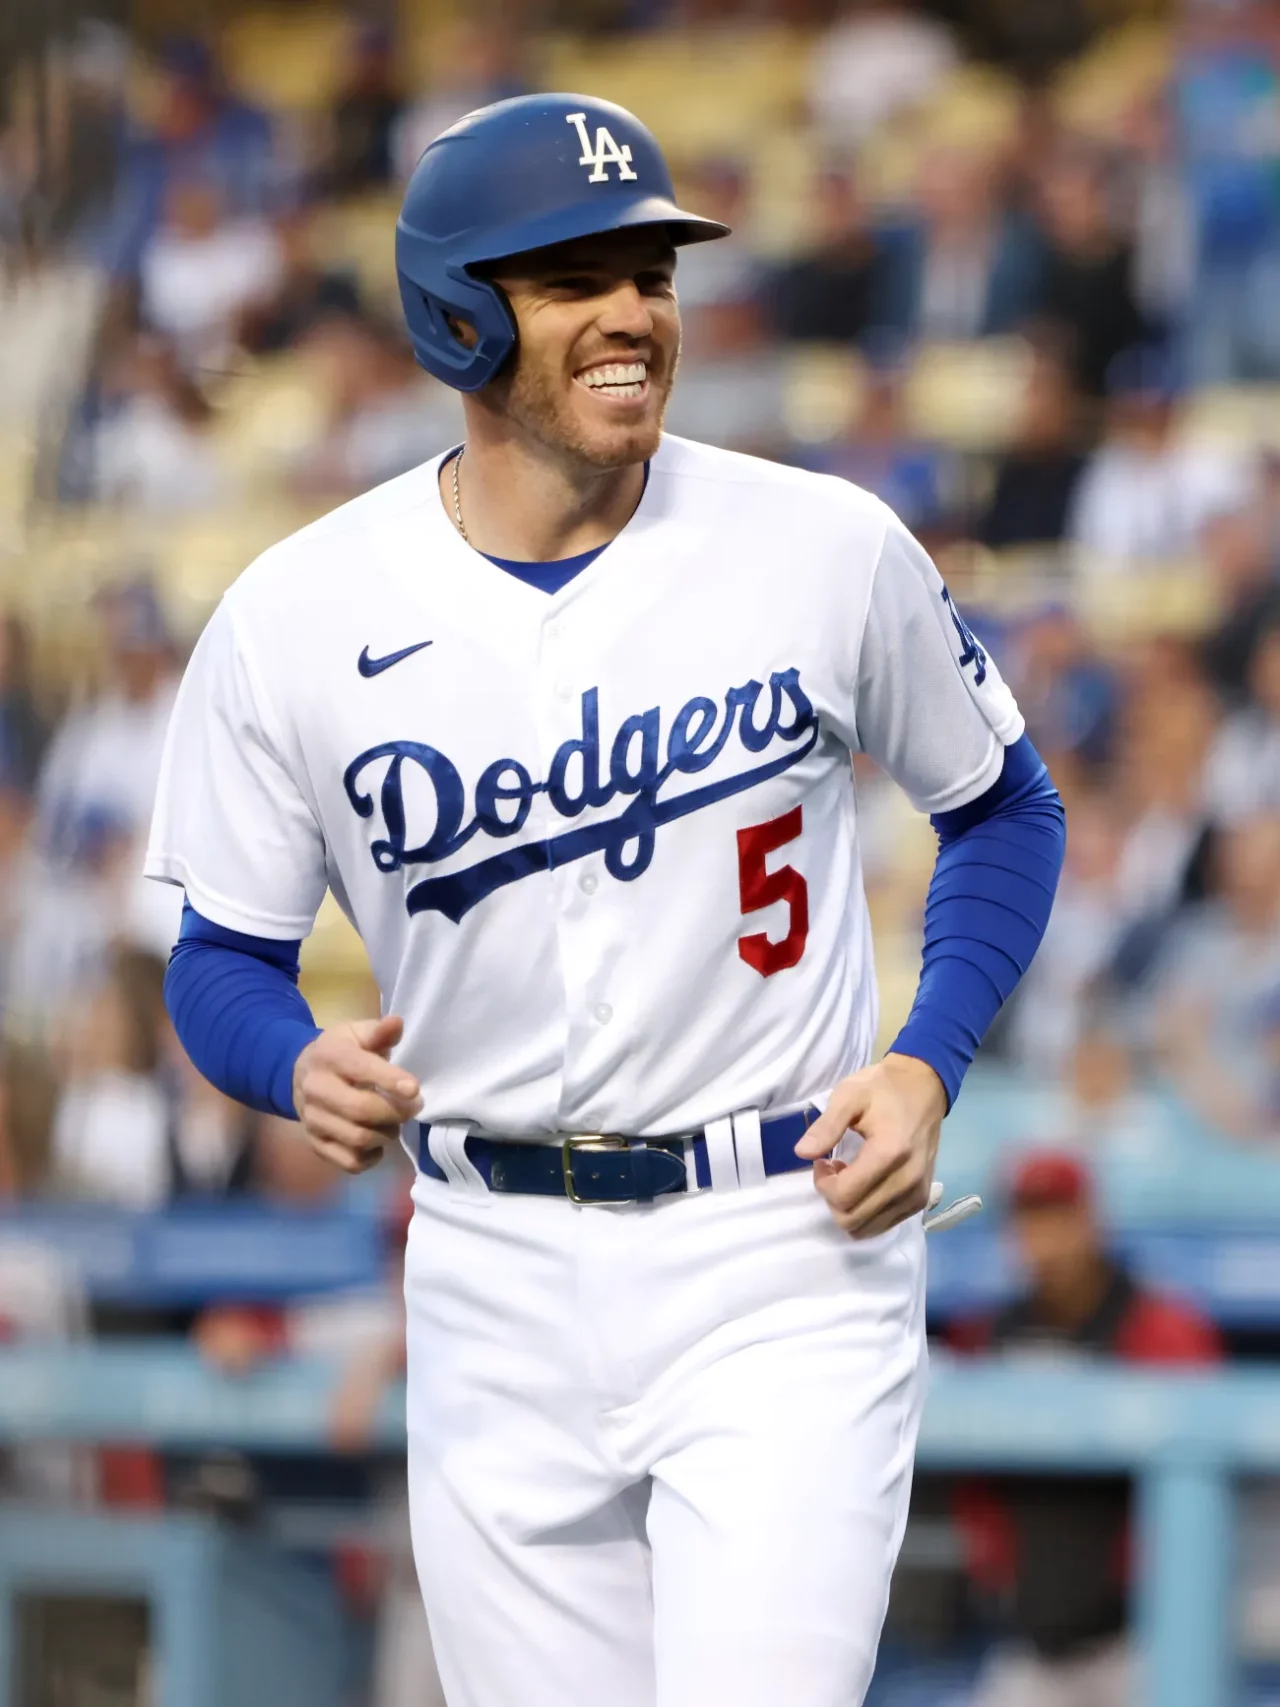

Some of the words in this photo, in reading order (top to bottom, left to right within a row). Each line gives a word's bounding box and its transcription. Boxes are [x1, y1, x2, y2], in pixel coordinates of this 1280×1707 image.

[565, 112, 638, 184] LA
[343, 667, 820, 882] Dodgers
[736, 804, 810, 979] 5
